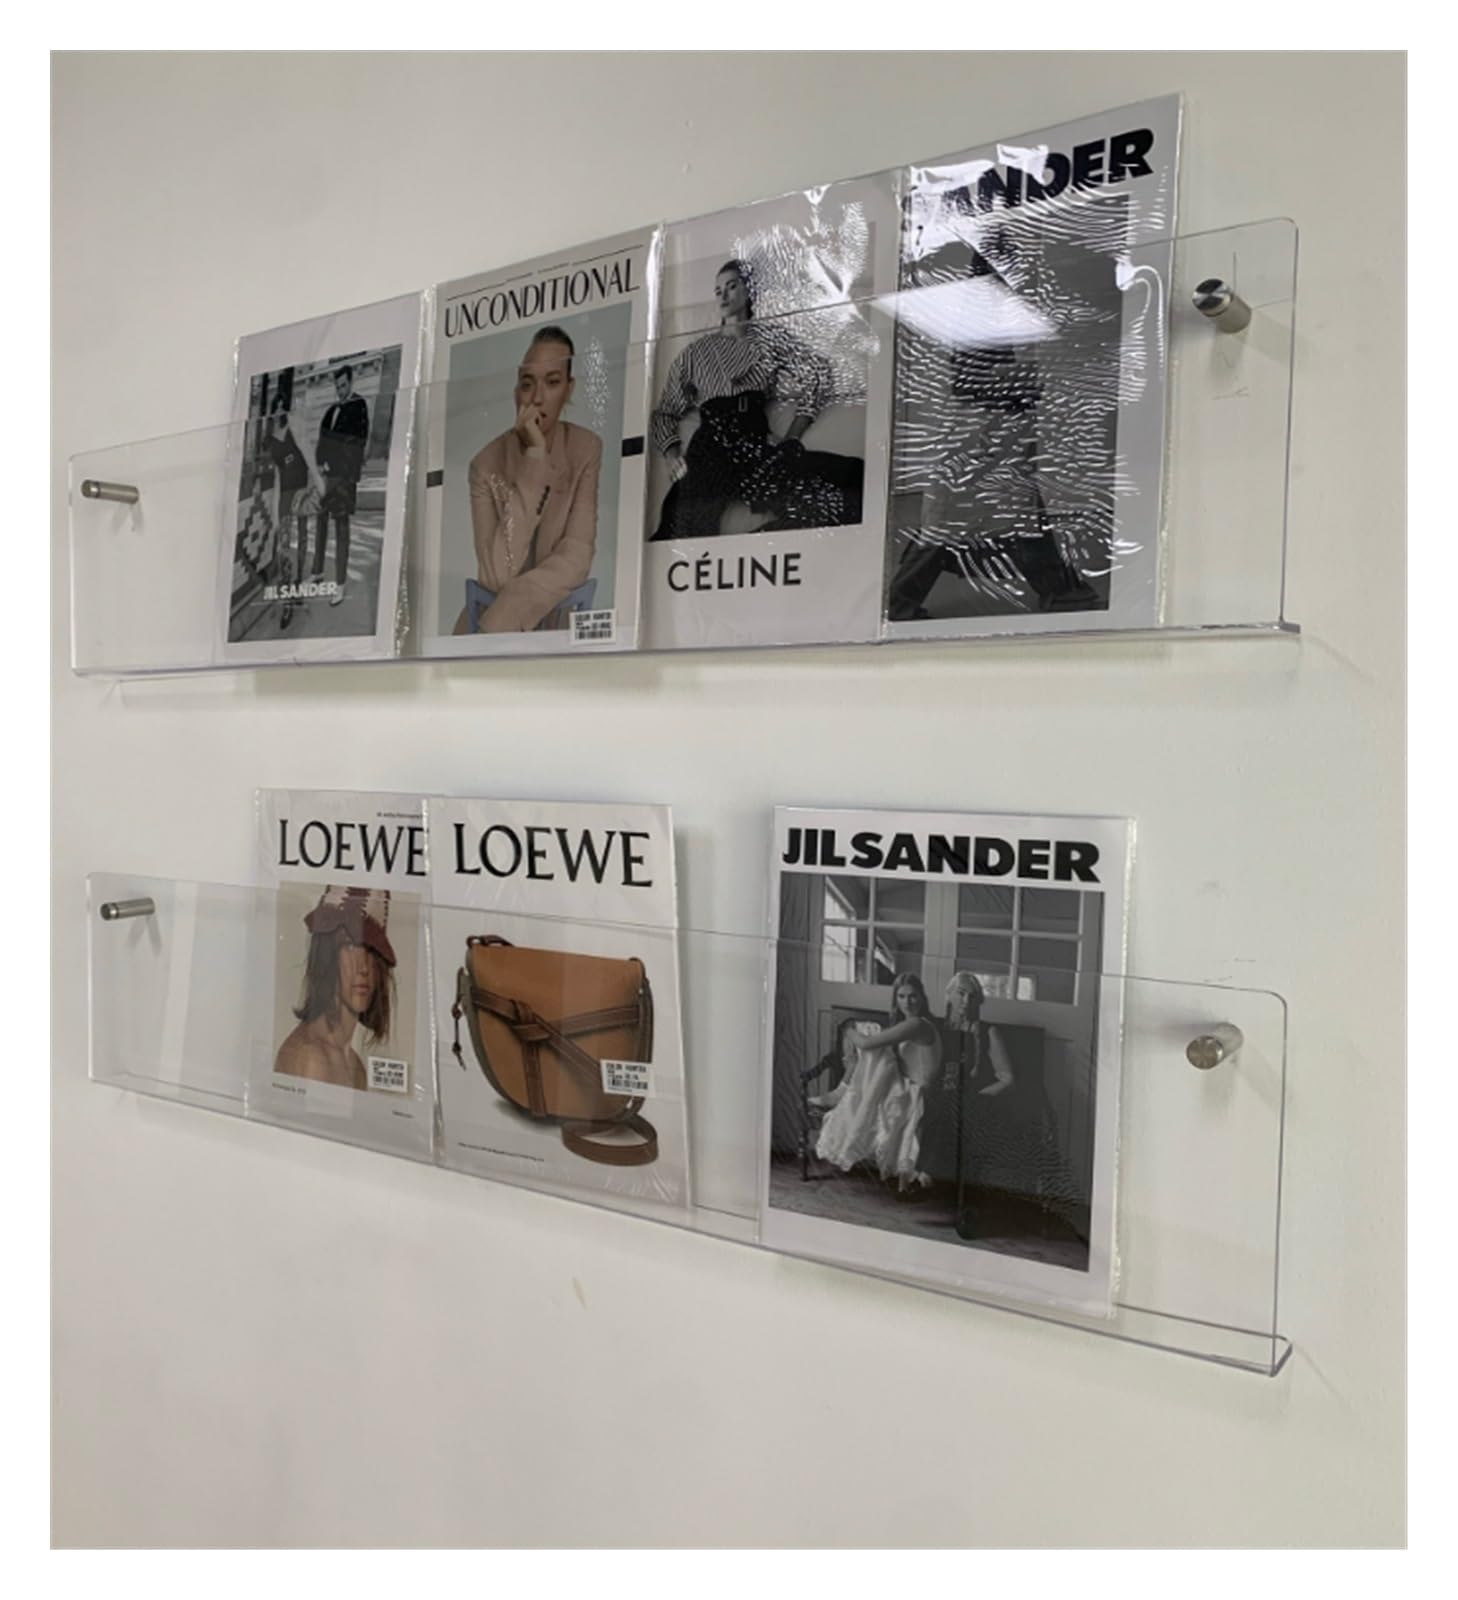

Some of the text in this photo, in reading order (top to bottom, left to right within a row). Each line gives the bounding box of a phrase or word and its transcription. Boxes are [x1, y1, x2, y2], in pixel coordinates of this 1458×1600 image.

[904, 128, 1154, 218] ANDER
[444, 258, 640, 338] UNCONDITIONAL
[667, 551, 802, 592] CÉLINE
[278, 819, 428, 877] LOEWE
[453, 823, 653, 888] LOEWE
